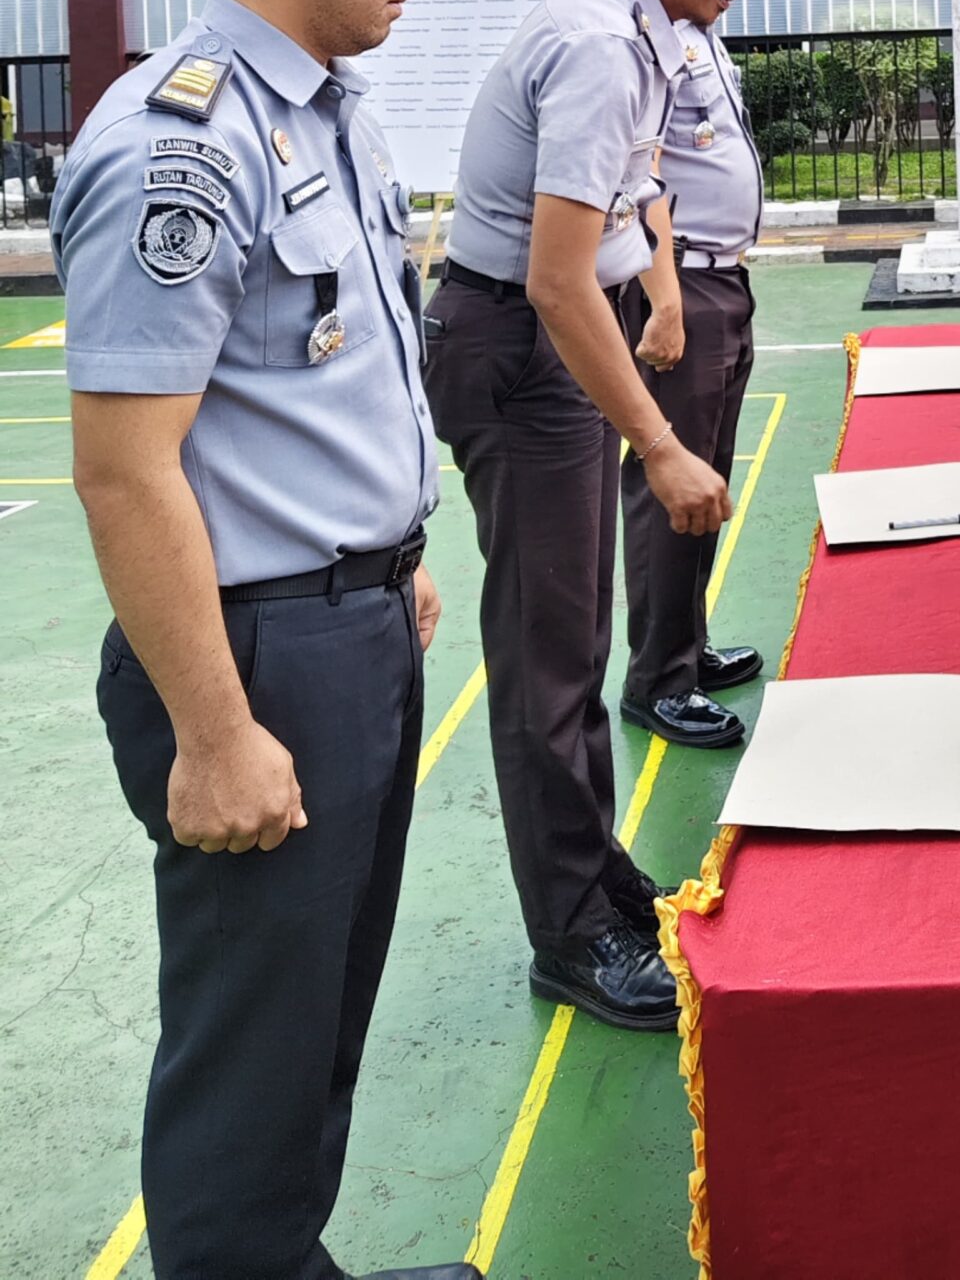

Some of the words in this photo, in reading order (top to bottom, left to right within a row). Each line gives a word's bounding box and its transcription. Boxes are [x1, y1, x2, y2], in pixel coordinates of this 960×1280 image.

[157, 138, 199, 153] KANWIL
[201, 145, 235, 170] SUMUT
[152, 171, 183, 184] RUTAN
[185, 173, 225, 201] TARUTUNG
